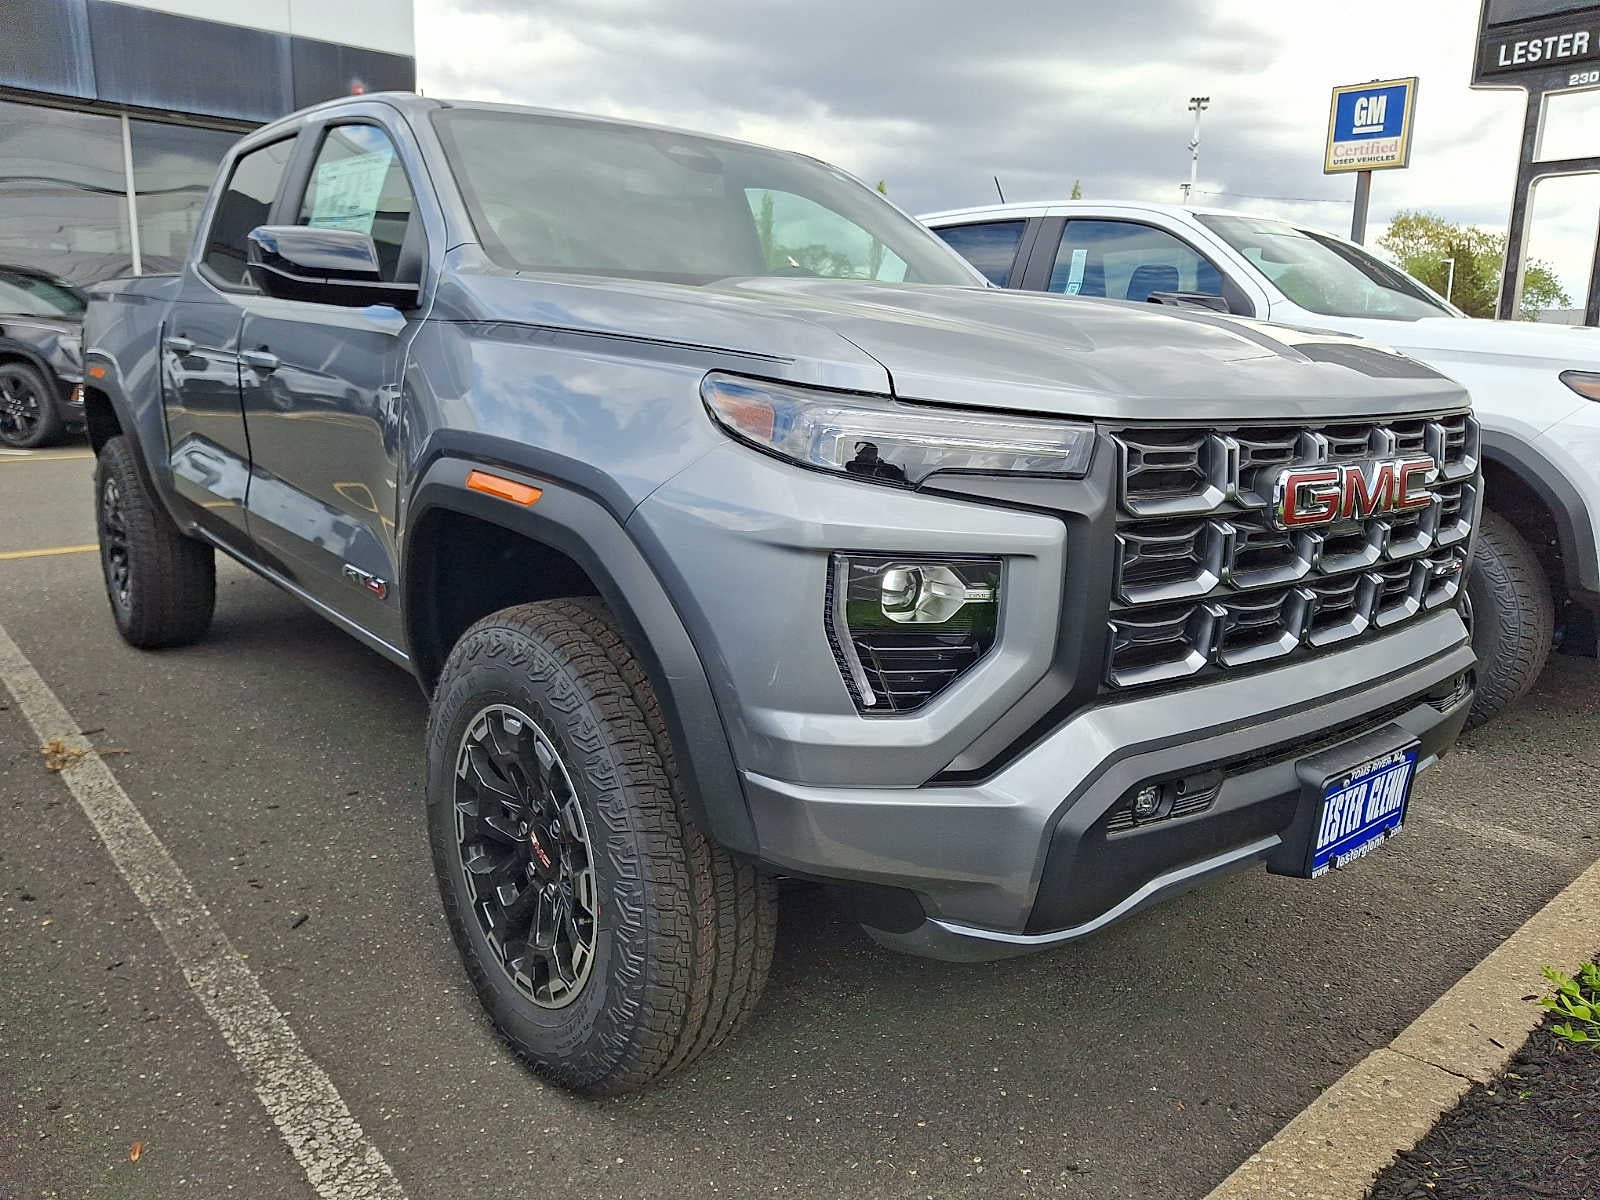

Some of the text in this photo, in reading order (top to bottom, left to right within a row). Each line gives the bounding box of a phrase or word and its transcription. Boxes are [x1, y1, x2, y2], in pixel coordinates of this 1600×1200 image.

[1498, 31, 1590, 67] LESTER
[1568, 71, 1600, 86] 230
[1353, 95, 1387, 127] GM
[1333, 140, 1399, 157] Certified
[1357, 154, 1396, 163] VEHICLES
[1274, 458, 1437, 530] GMC
[1316, 764, 1411, 850] LESTER GLENN
